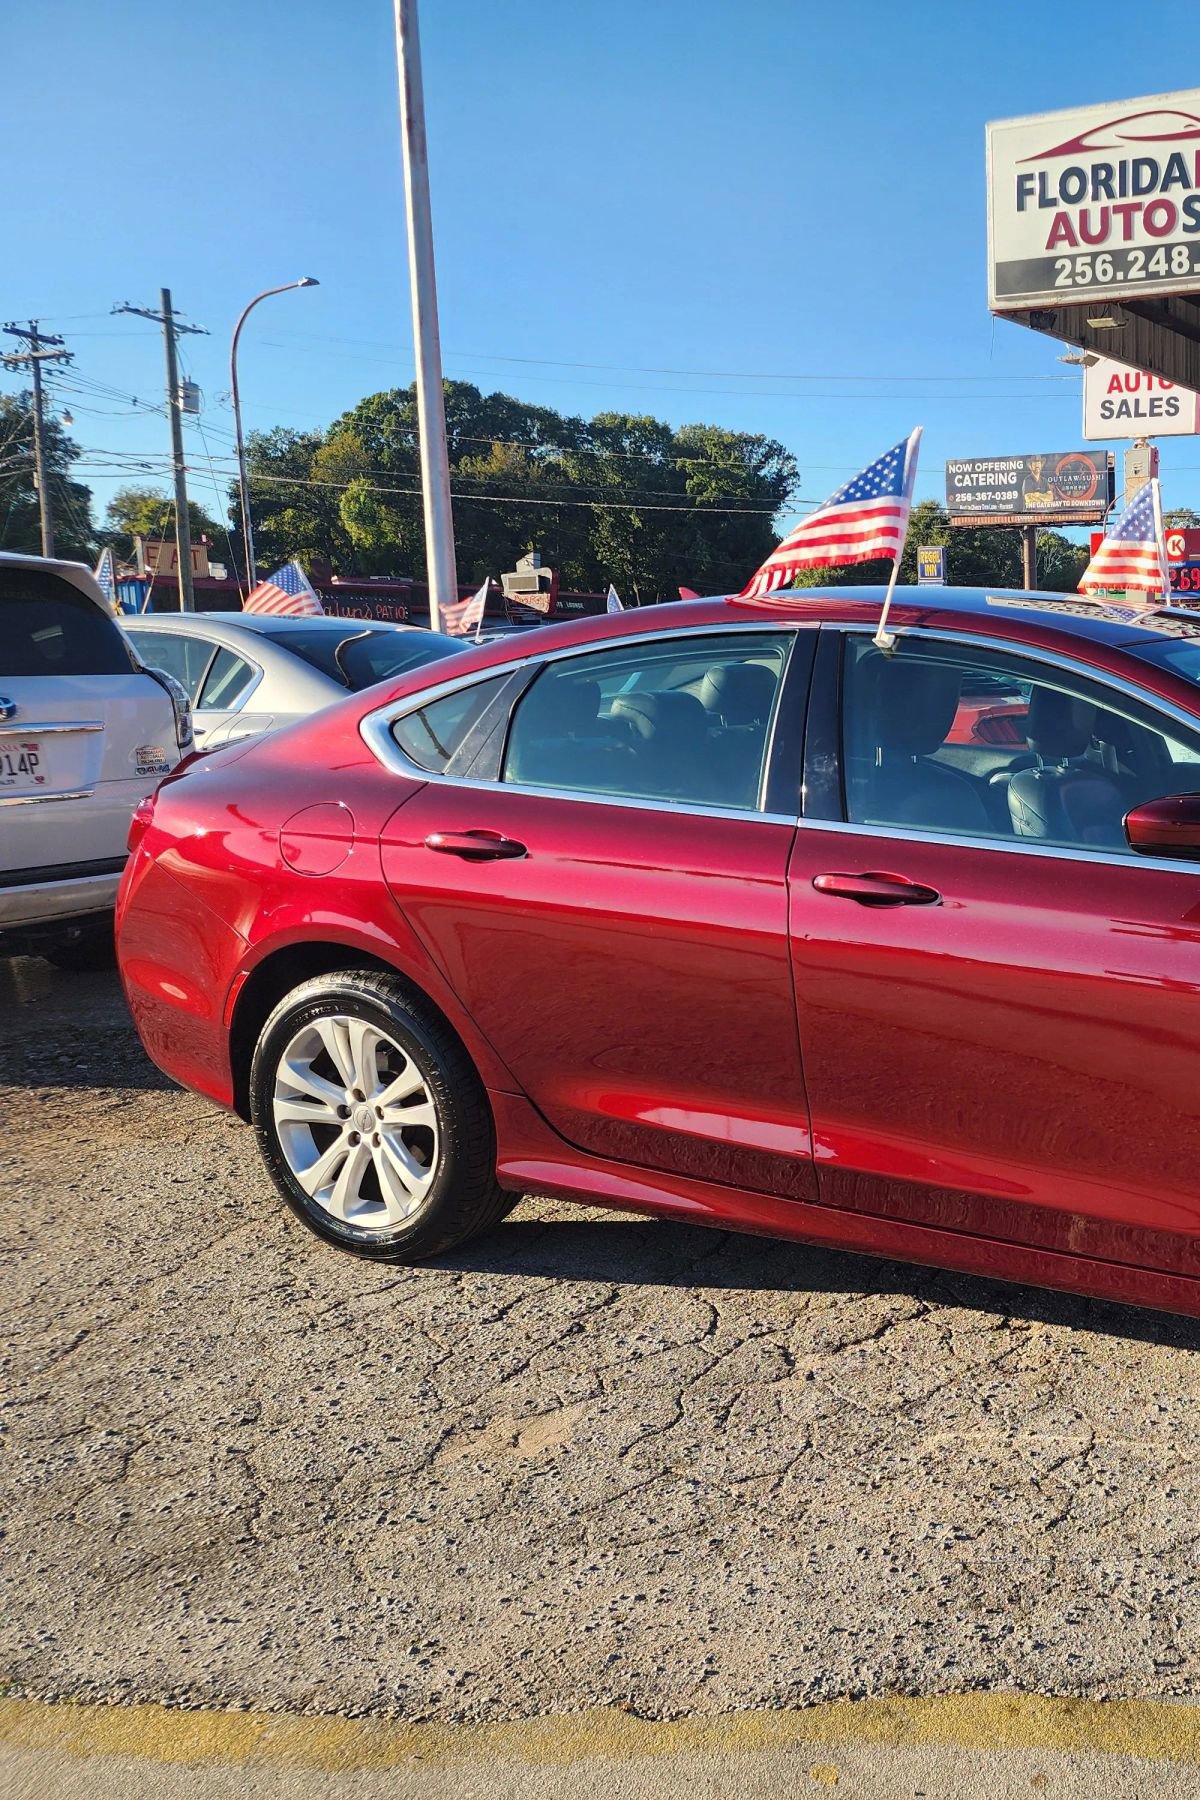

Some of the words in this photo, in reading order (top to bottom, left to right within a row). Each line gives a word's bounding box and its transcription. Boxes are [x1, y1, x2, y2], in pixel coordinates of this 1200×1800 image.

[1100, 396, 1180, 420] SALES
[948, 463, 972, 474] NOW
[974, 460, 1024, 472] OFFERING
[954, 472, 1017, 487] CATERING
[1047, 475, 1080, 483] OUTLAW
[1082, 473, 1104, 481] SUSHI
[955, 491, 1018, 502] 256-367-0389
[1036, 500, 1062, 508] GATEWAY
[1070, 499, 1106, 507] DOWNTOWN
[920, 550, 940, 564] REGAL
[925, 564, 937, 577] INN
